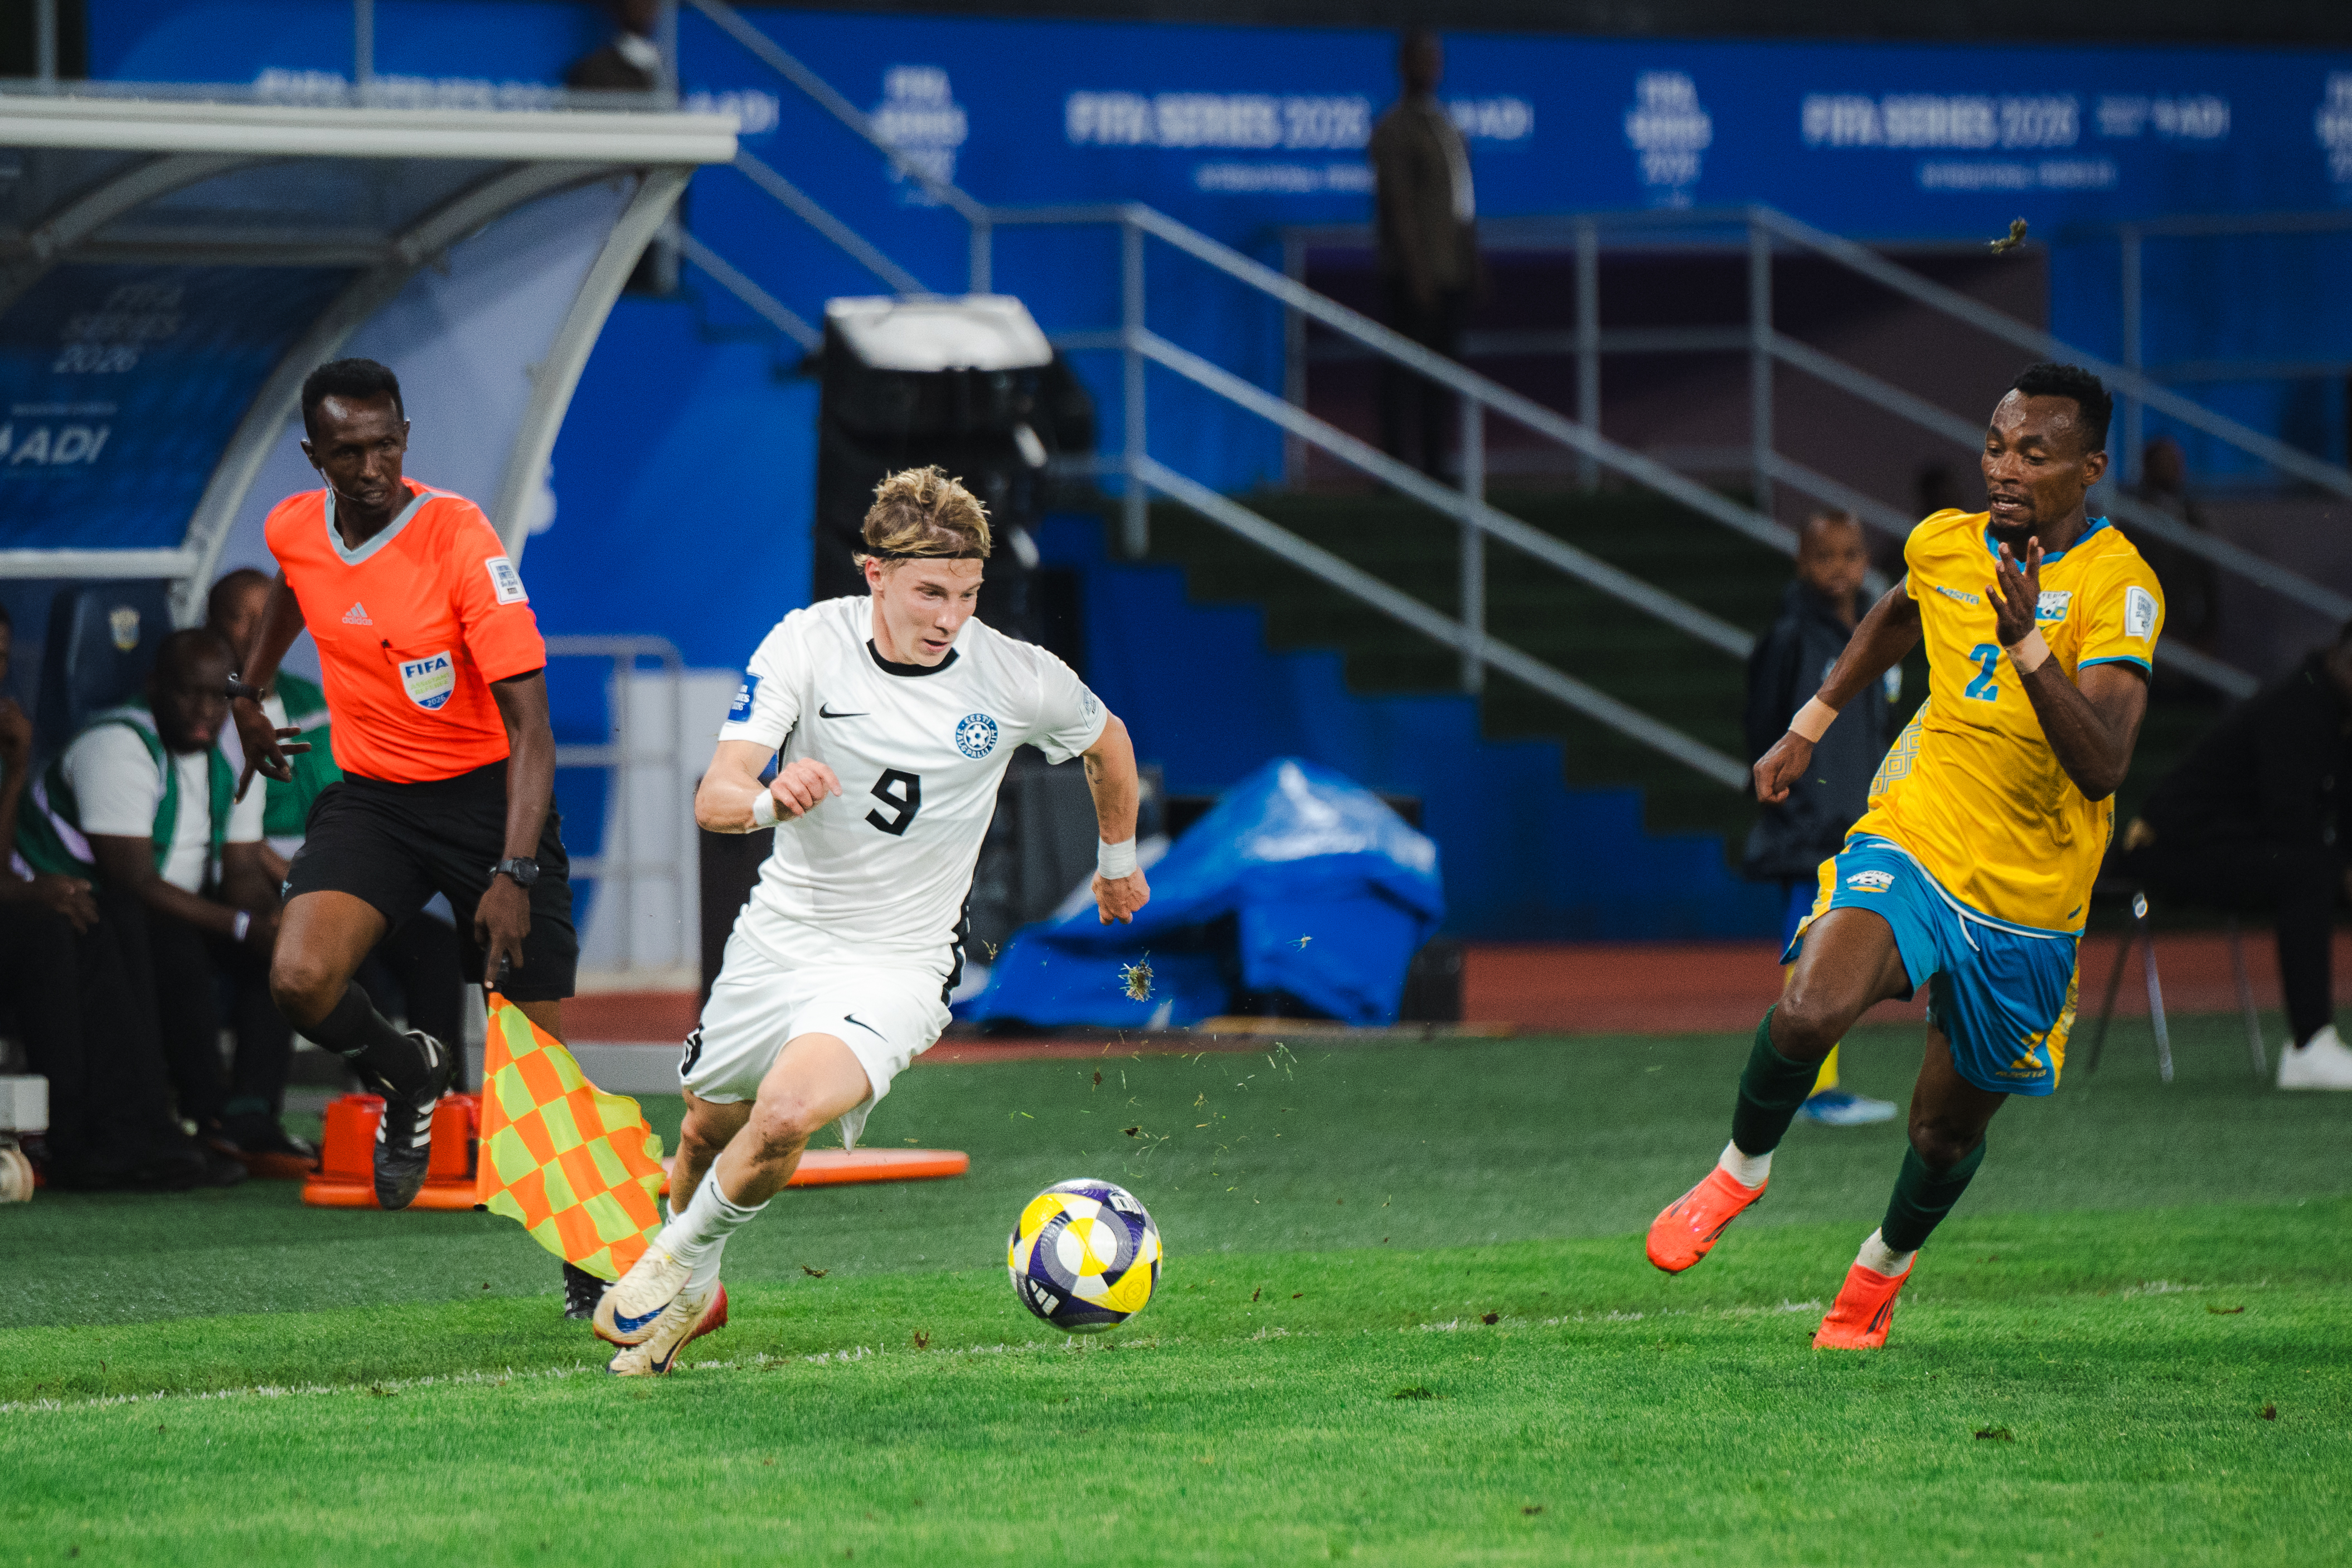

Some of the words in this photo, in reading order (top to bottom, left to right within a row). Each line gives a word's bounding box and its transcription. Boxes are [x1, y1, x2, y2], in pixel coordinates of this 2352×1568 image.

[1066, 91, 1151, 145] FIFA
[1155, 92, 1282, 148] SERIES
[1802, 94, 1876, 147] FIFA
[1880, 95, 1996, 148] SERIES
[342, 616, 373, 626] adidas
[405, 657, 449, 678] FIFA
[1963, 643, 2001, 702] 2
[426, 695, 446, 707] 2026
[964, 715, 992, 725] EESTI
[956, 728, 990, 758] JALGPALLI
[988, 729, 997, 747] LIIT
[864, 768, 922, 837] 9
